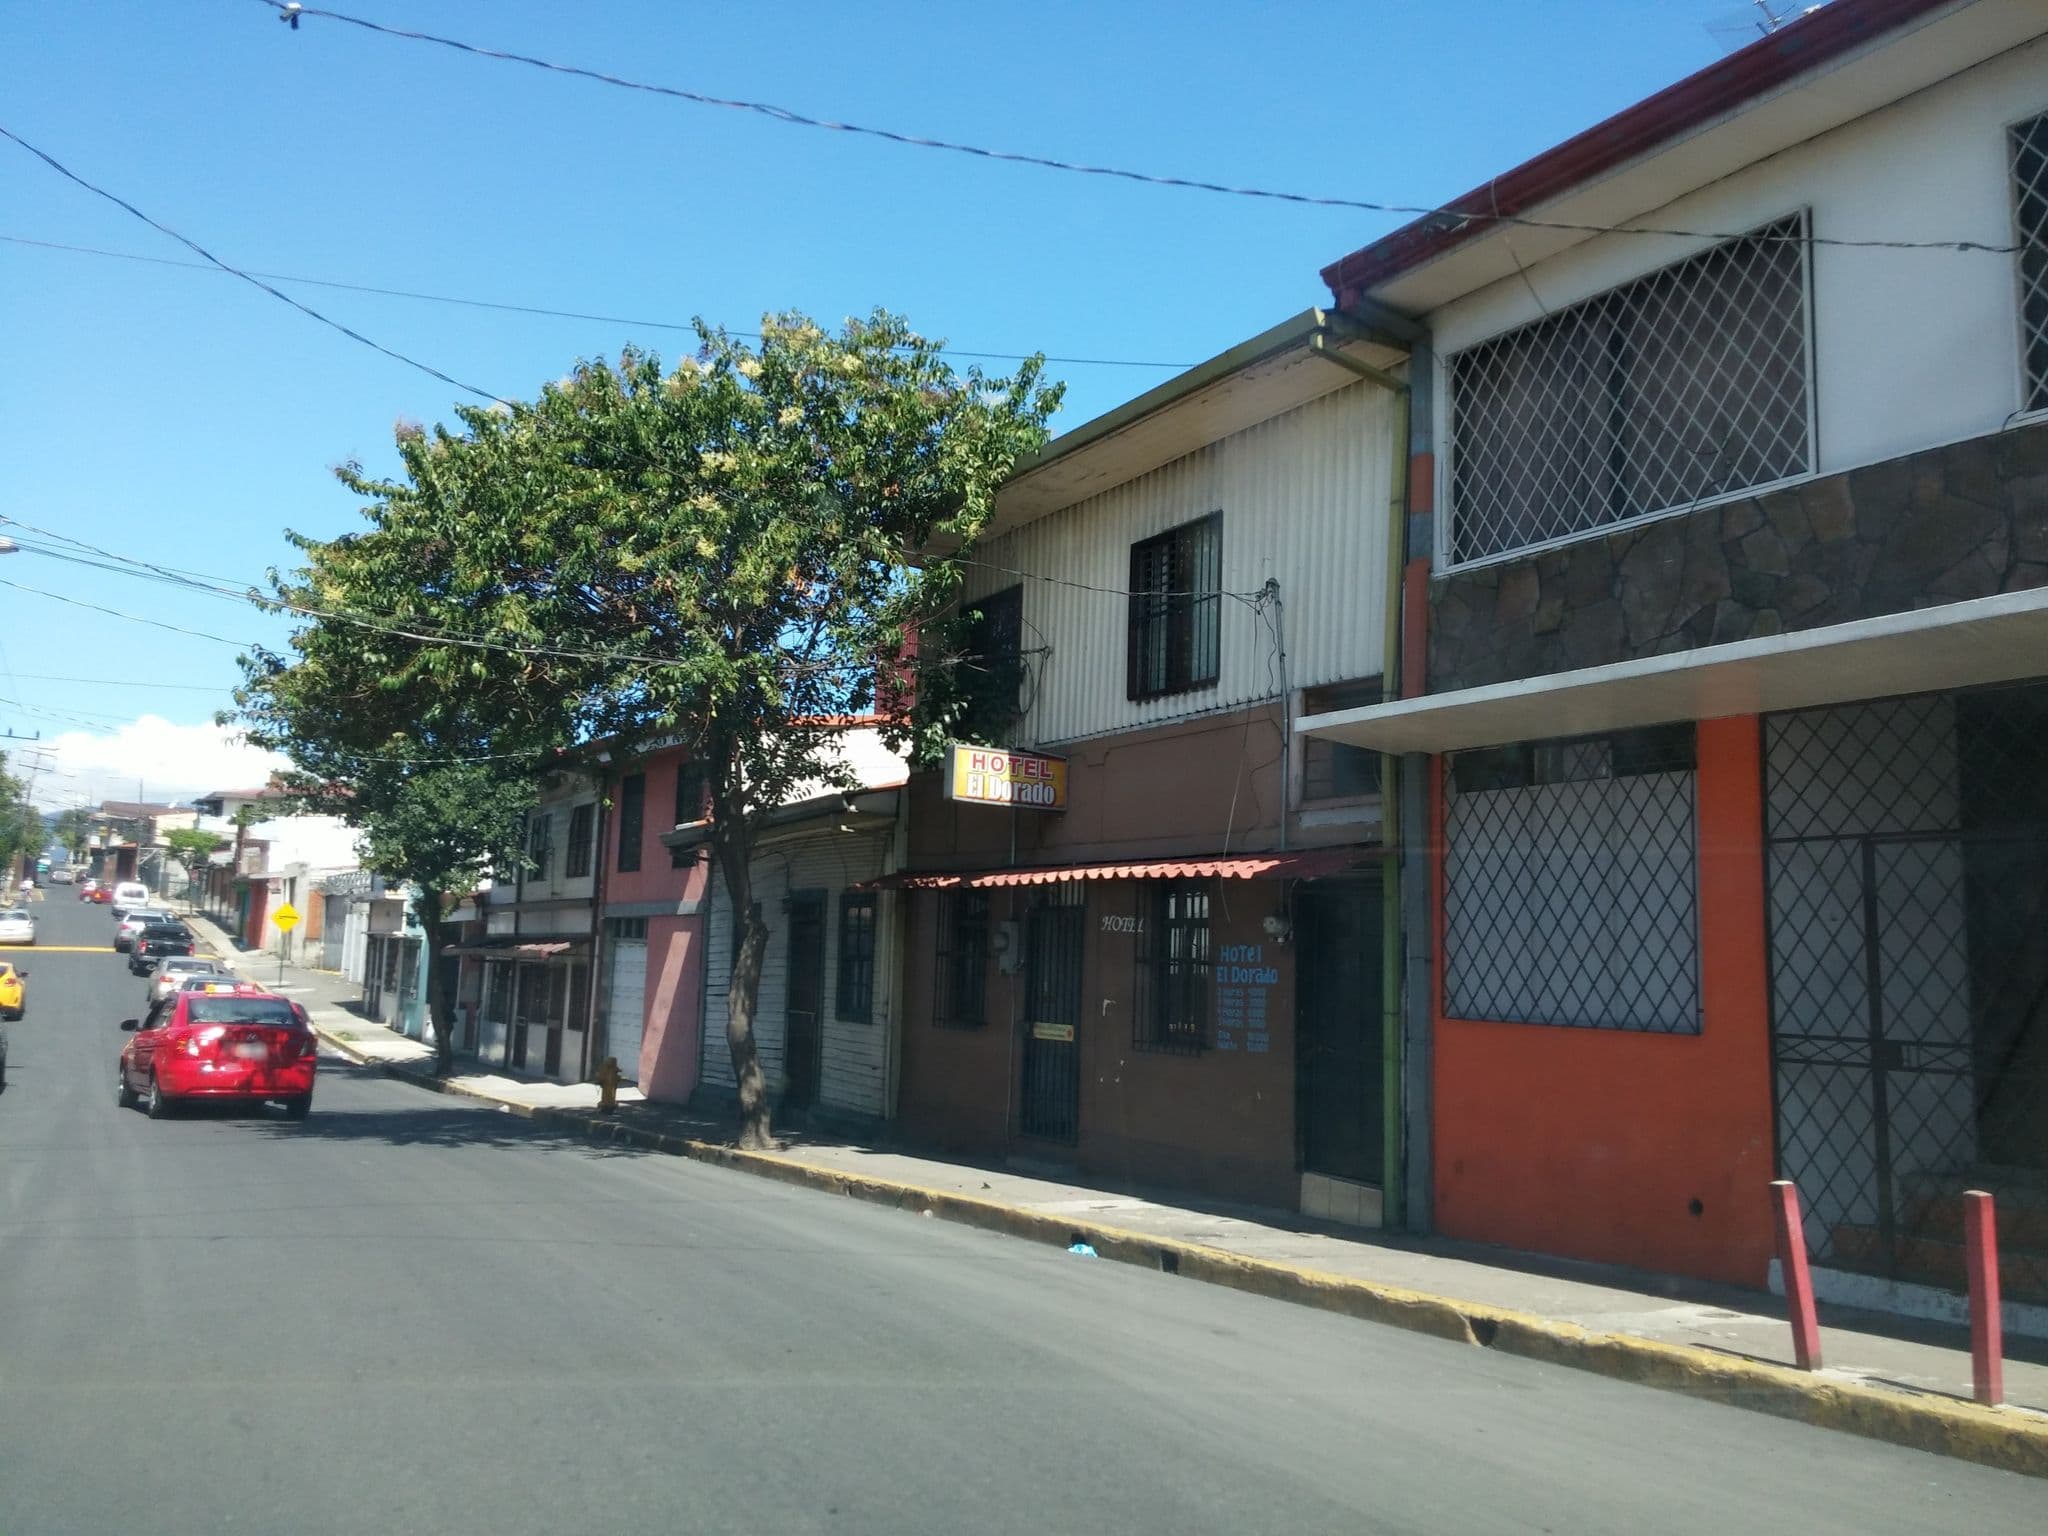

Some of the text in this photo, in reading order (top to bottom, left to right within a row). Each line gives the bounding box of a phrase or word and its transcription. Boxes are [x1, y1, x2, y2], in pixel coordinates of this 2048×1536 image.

[971, 753, 1053, 779] HOTEL
[967, 773, 1056, 805] El Dorado
[1216, 966, 1278, 985] El Dorado
